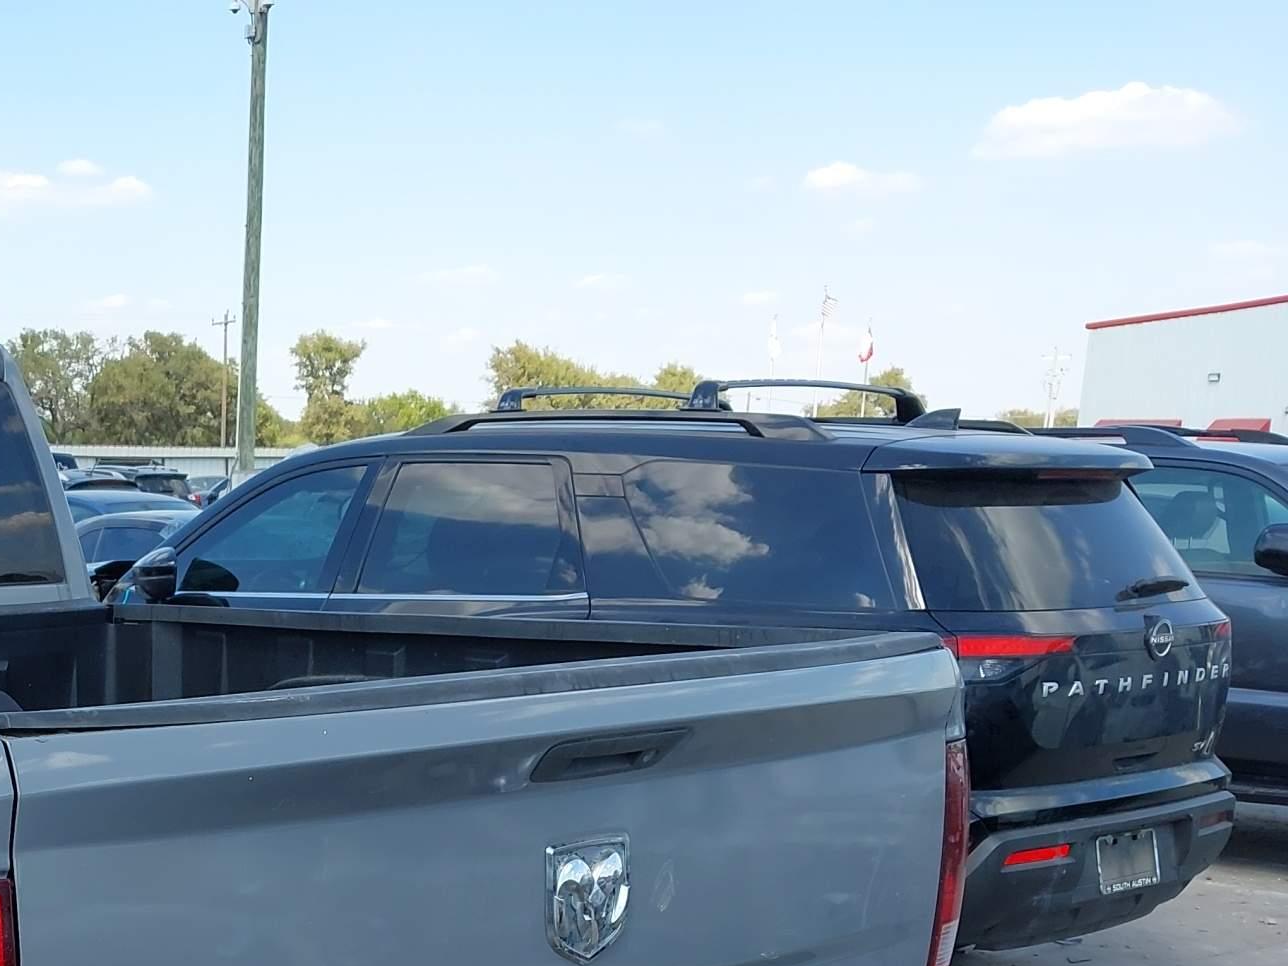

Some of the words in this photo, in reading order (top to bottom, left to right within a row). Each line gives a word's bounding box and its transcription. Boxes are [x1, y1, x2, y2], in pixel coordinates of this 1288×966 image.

[1150, 634, 1175, 644] NISSAN
[1042, 663, 1230, 698] PATHFINDER
[1112, 881, 1131, 892] SOUTH
[1132, 877, 1152, 889] AUSTIN
